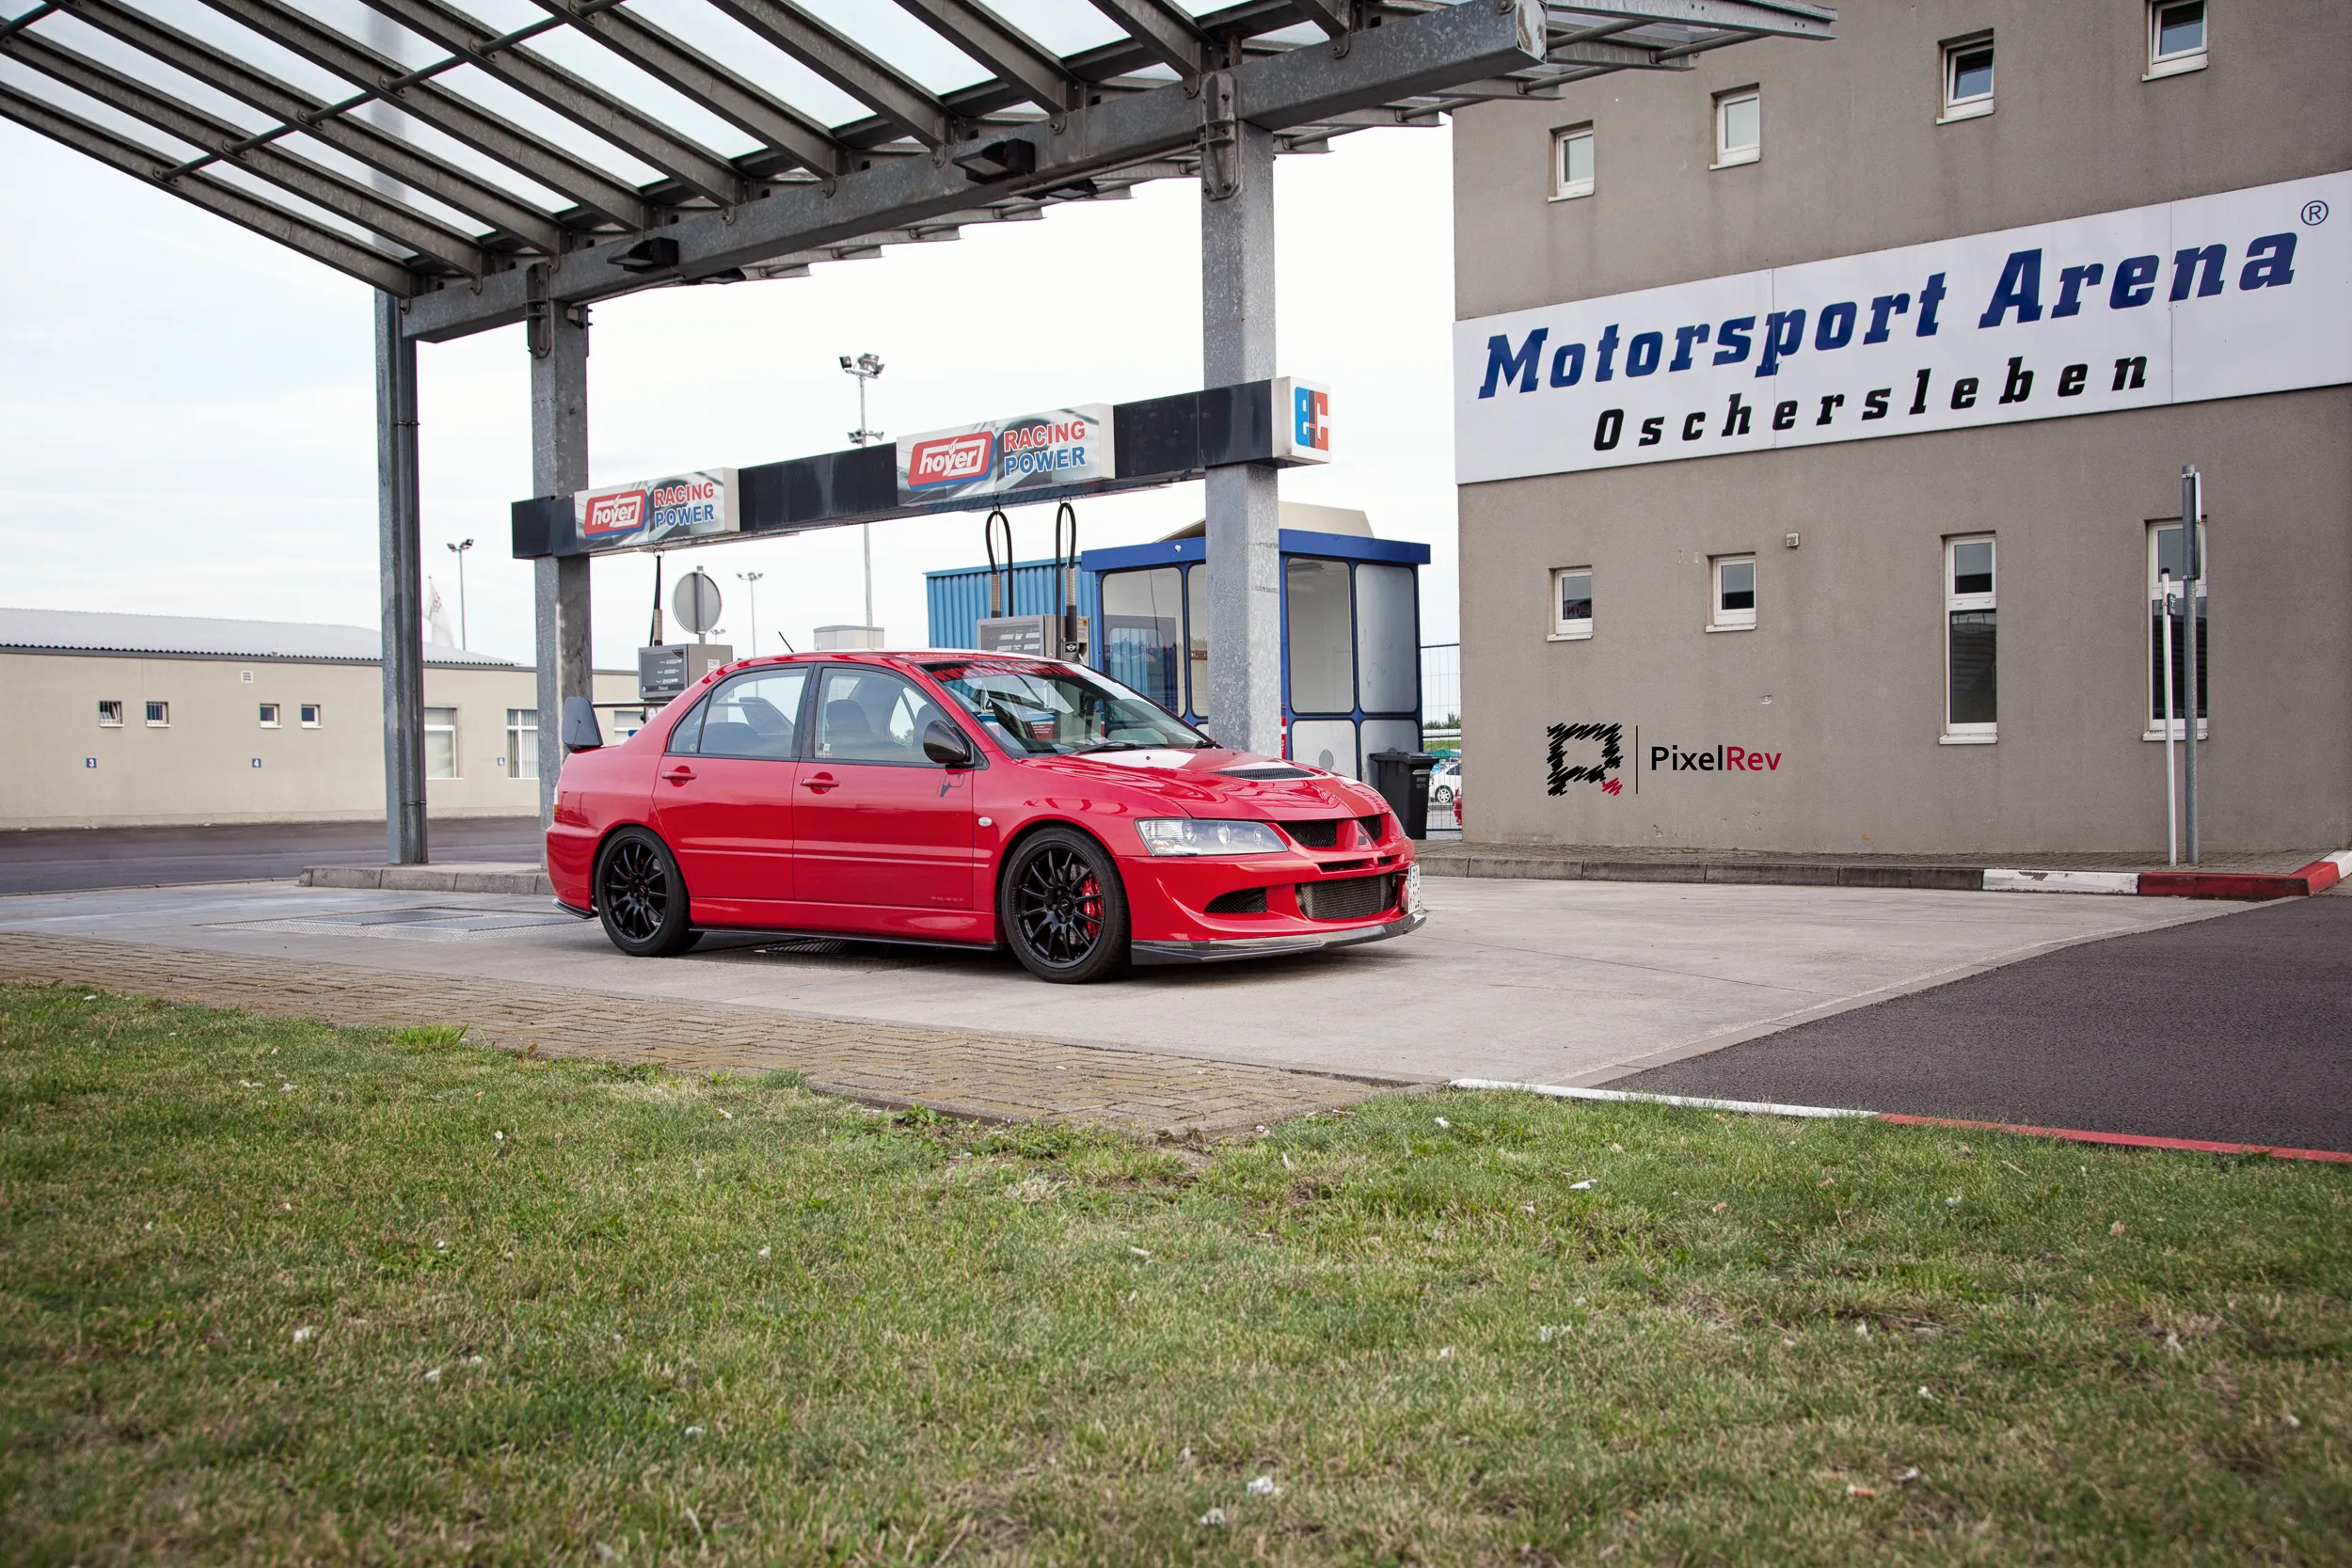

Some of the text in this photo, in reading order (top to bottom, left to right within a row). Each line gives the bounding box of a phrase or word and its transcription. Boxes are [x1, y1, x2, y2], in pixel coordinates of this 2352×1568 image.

[1479, 272, 1947, 399] Motorsport
[1979, 231, 2298, 328] Arena
[1593, 356, 2148, 451] Oschersleben
[1003, 420, 1086, 451] RACING
[918, 444, 977, 477] hoyer
[1005, 447, 1088, 476] POWER
[654, 483, 714, 507] RACING
[591, 503, 635, 528] hoyer
[655, 504, 715, 528] POWER
[88, 758, 95, 768] 3
[253, 759, 260, 768] 4
